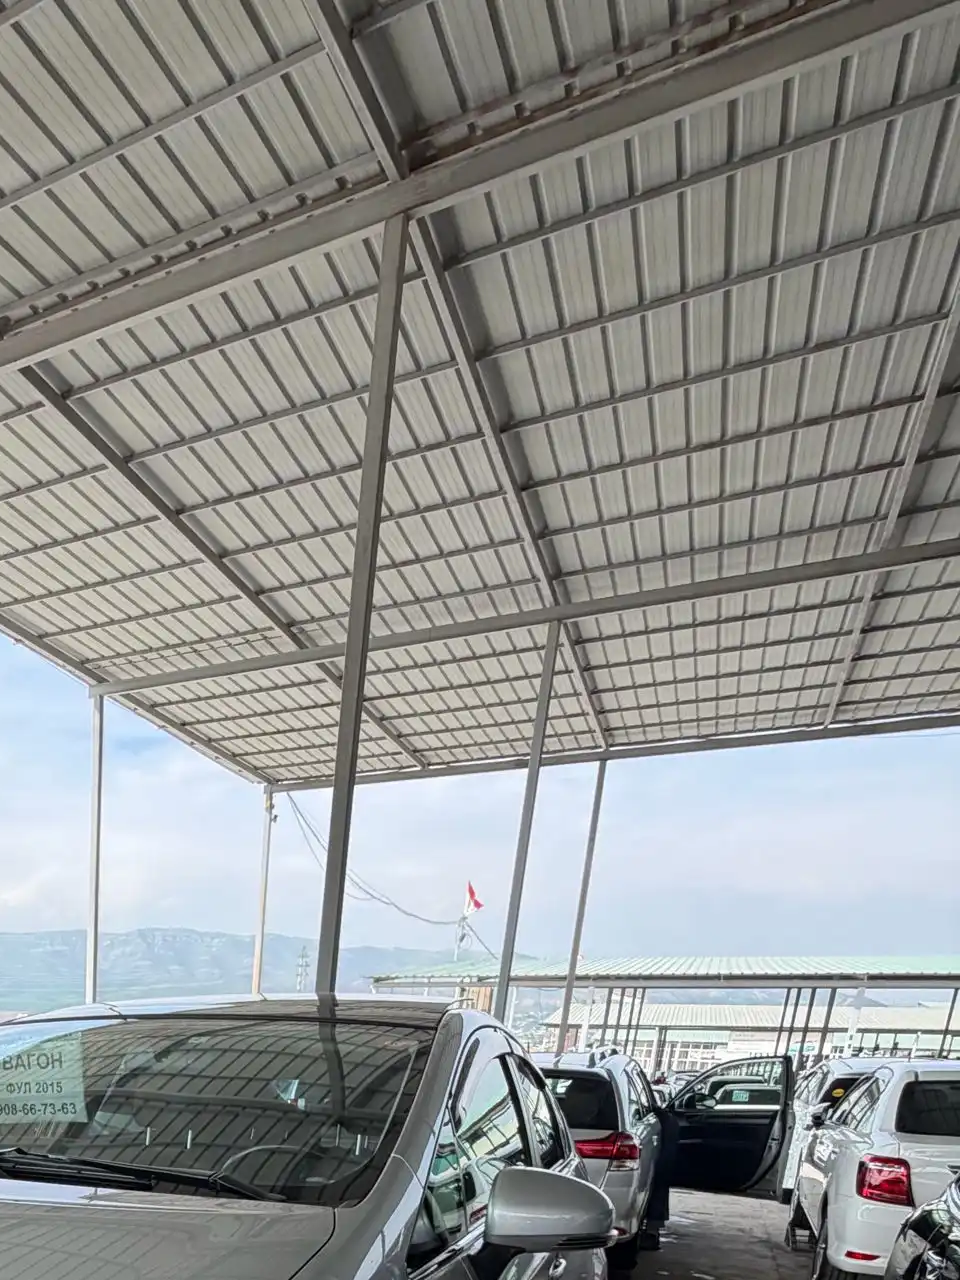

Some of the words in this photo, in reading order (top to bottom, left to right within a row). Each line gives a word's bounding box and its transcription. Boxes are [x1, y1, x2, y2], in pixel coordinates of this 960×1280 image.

[2, 1051, 63, 1071] ВАГОН
[6, 1082, 32, 1094] ФУЛ
[35, 1081, 63, 1094] 2015
